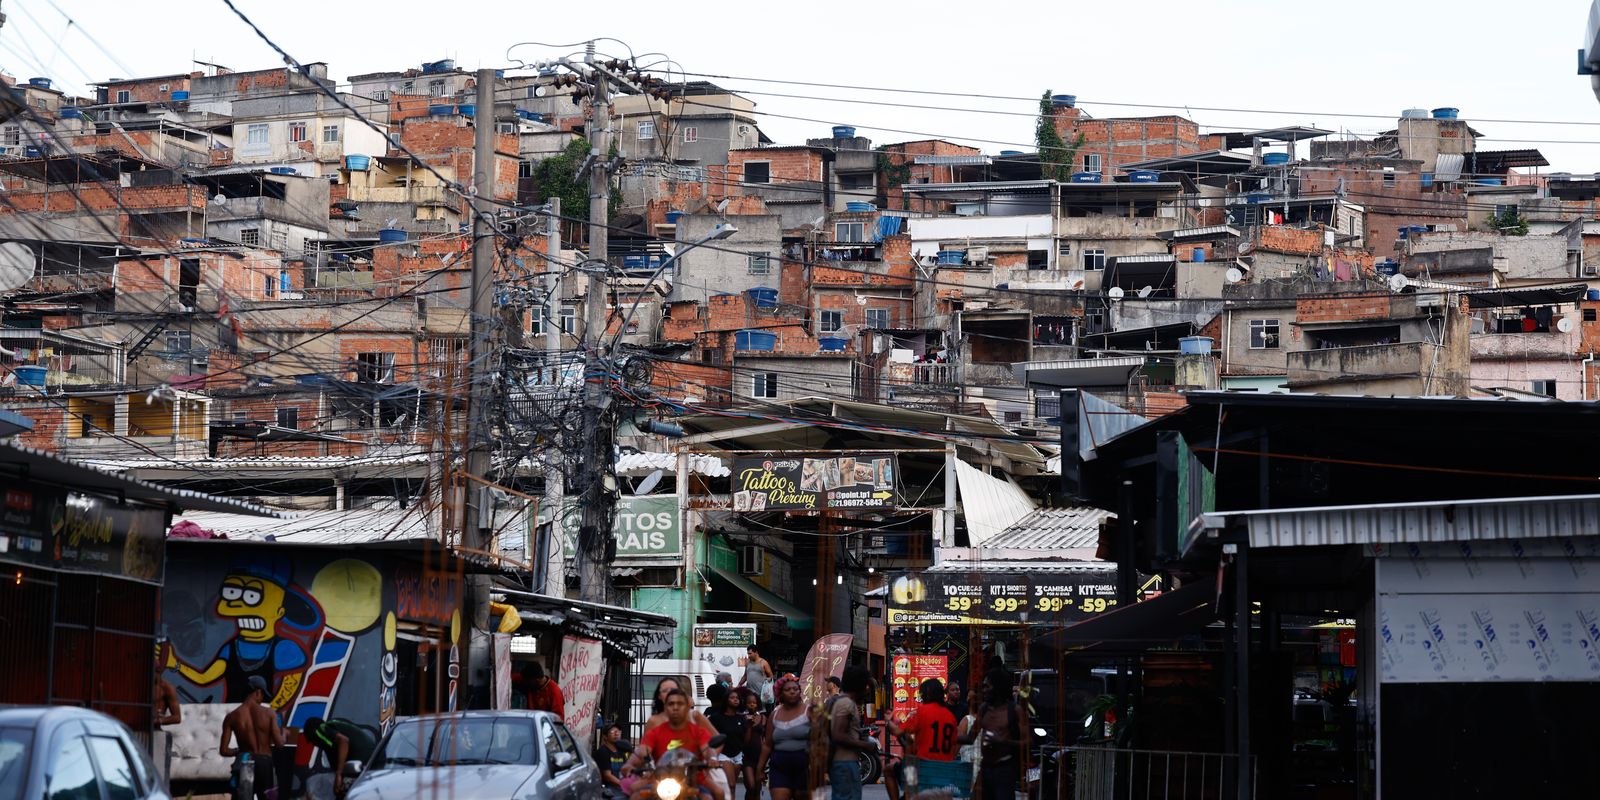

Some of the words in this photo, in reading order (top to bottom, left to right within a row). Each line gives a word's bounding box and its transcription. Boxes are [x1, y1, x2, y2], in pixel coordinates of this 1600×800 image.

[740, 468, 787, 491] Tattoo
[787, 481, 796, 493] &
[768, 488, 816, 509] Piercing
[943, 585, 958, 596] 10
[990, 585, 1001, 595] KIT
[1001, 585, 1007, 596] 3
[1034, 585, 1044, 596] 3
[1078, 585, 1095, 596] KIT
[928, 721, 954, 754] 18
